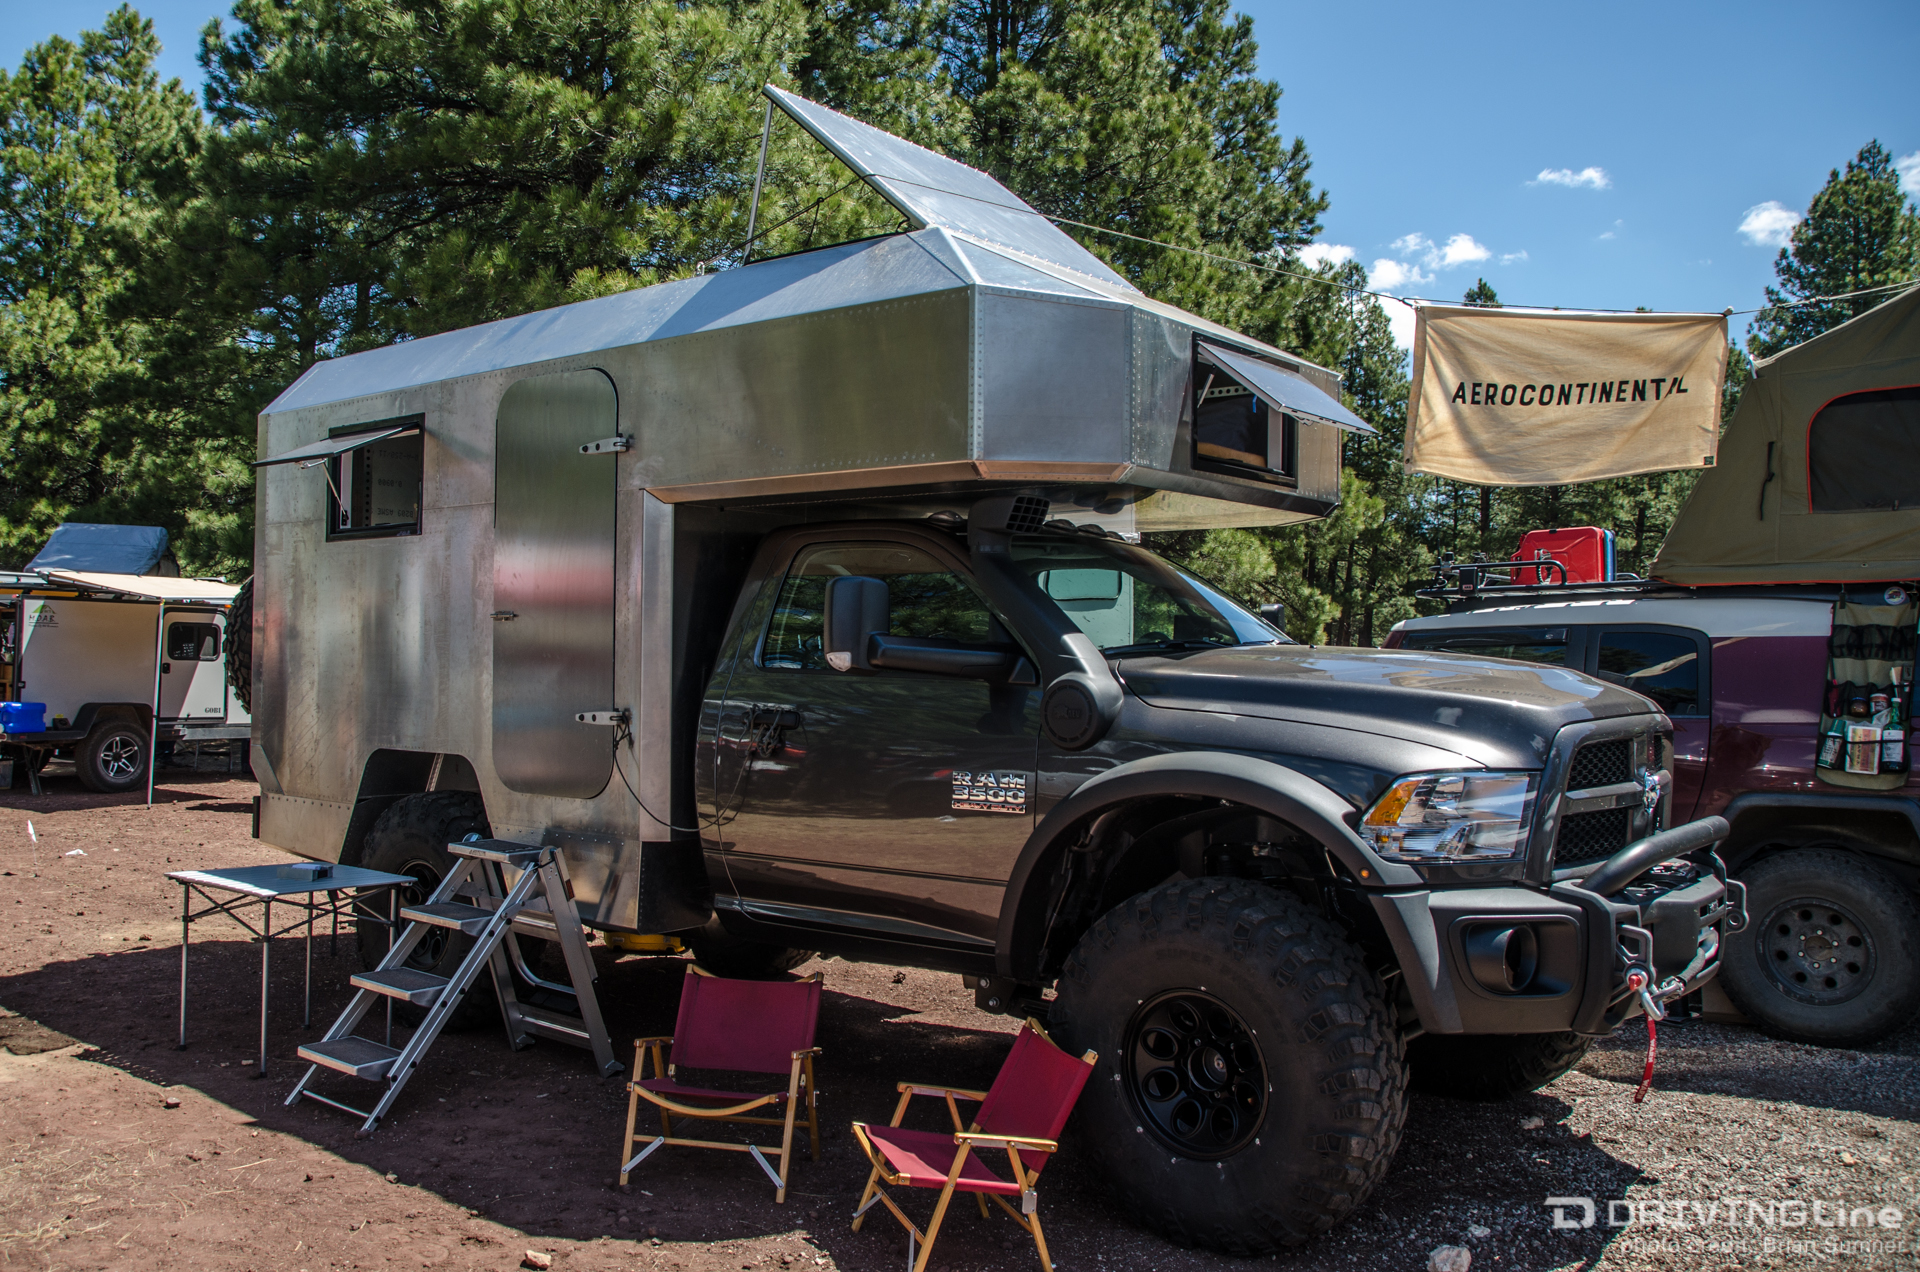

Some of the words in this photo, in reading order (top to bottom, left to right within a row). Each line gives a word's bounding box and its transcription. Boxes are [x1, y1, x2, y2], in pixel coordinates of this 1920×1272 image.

[204, 706, 221, 714] GOBI
[952, 771, 1026, 788] RAM
[952, 786, 1026, 803] 3500
